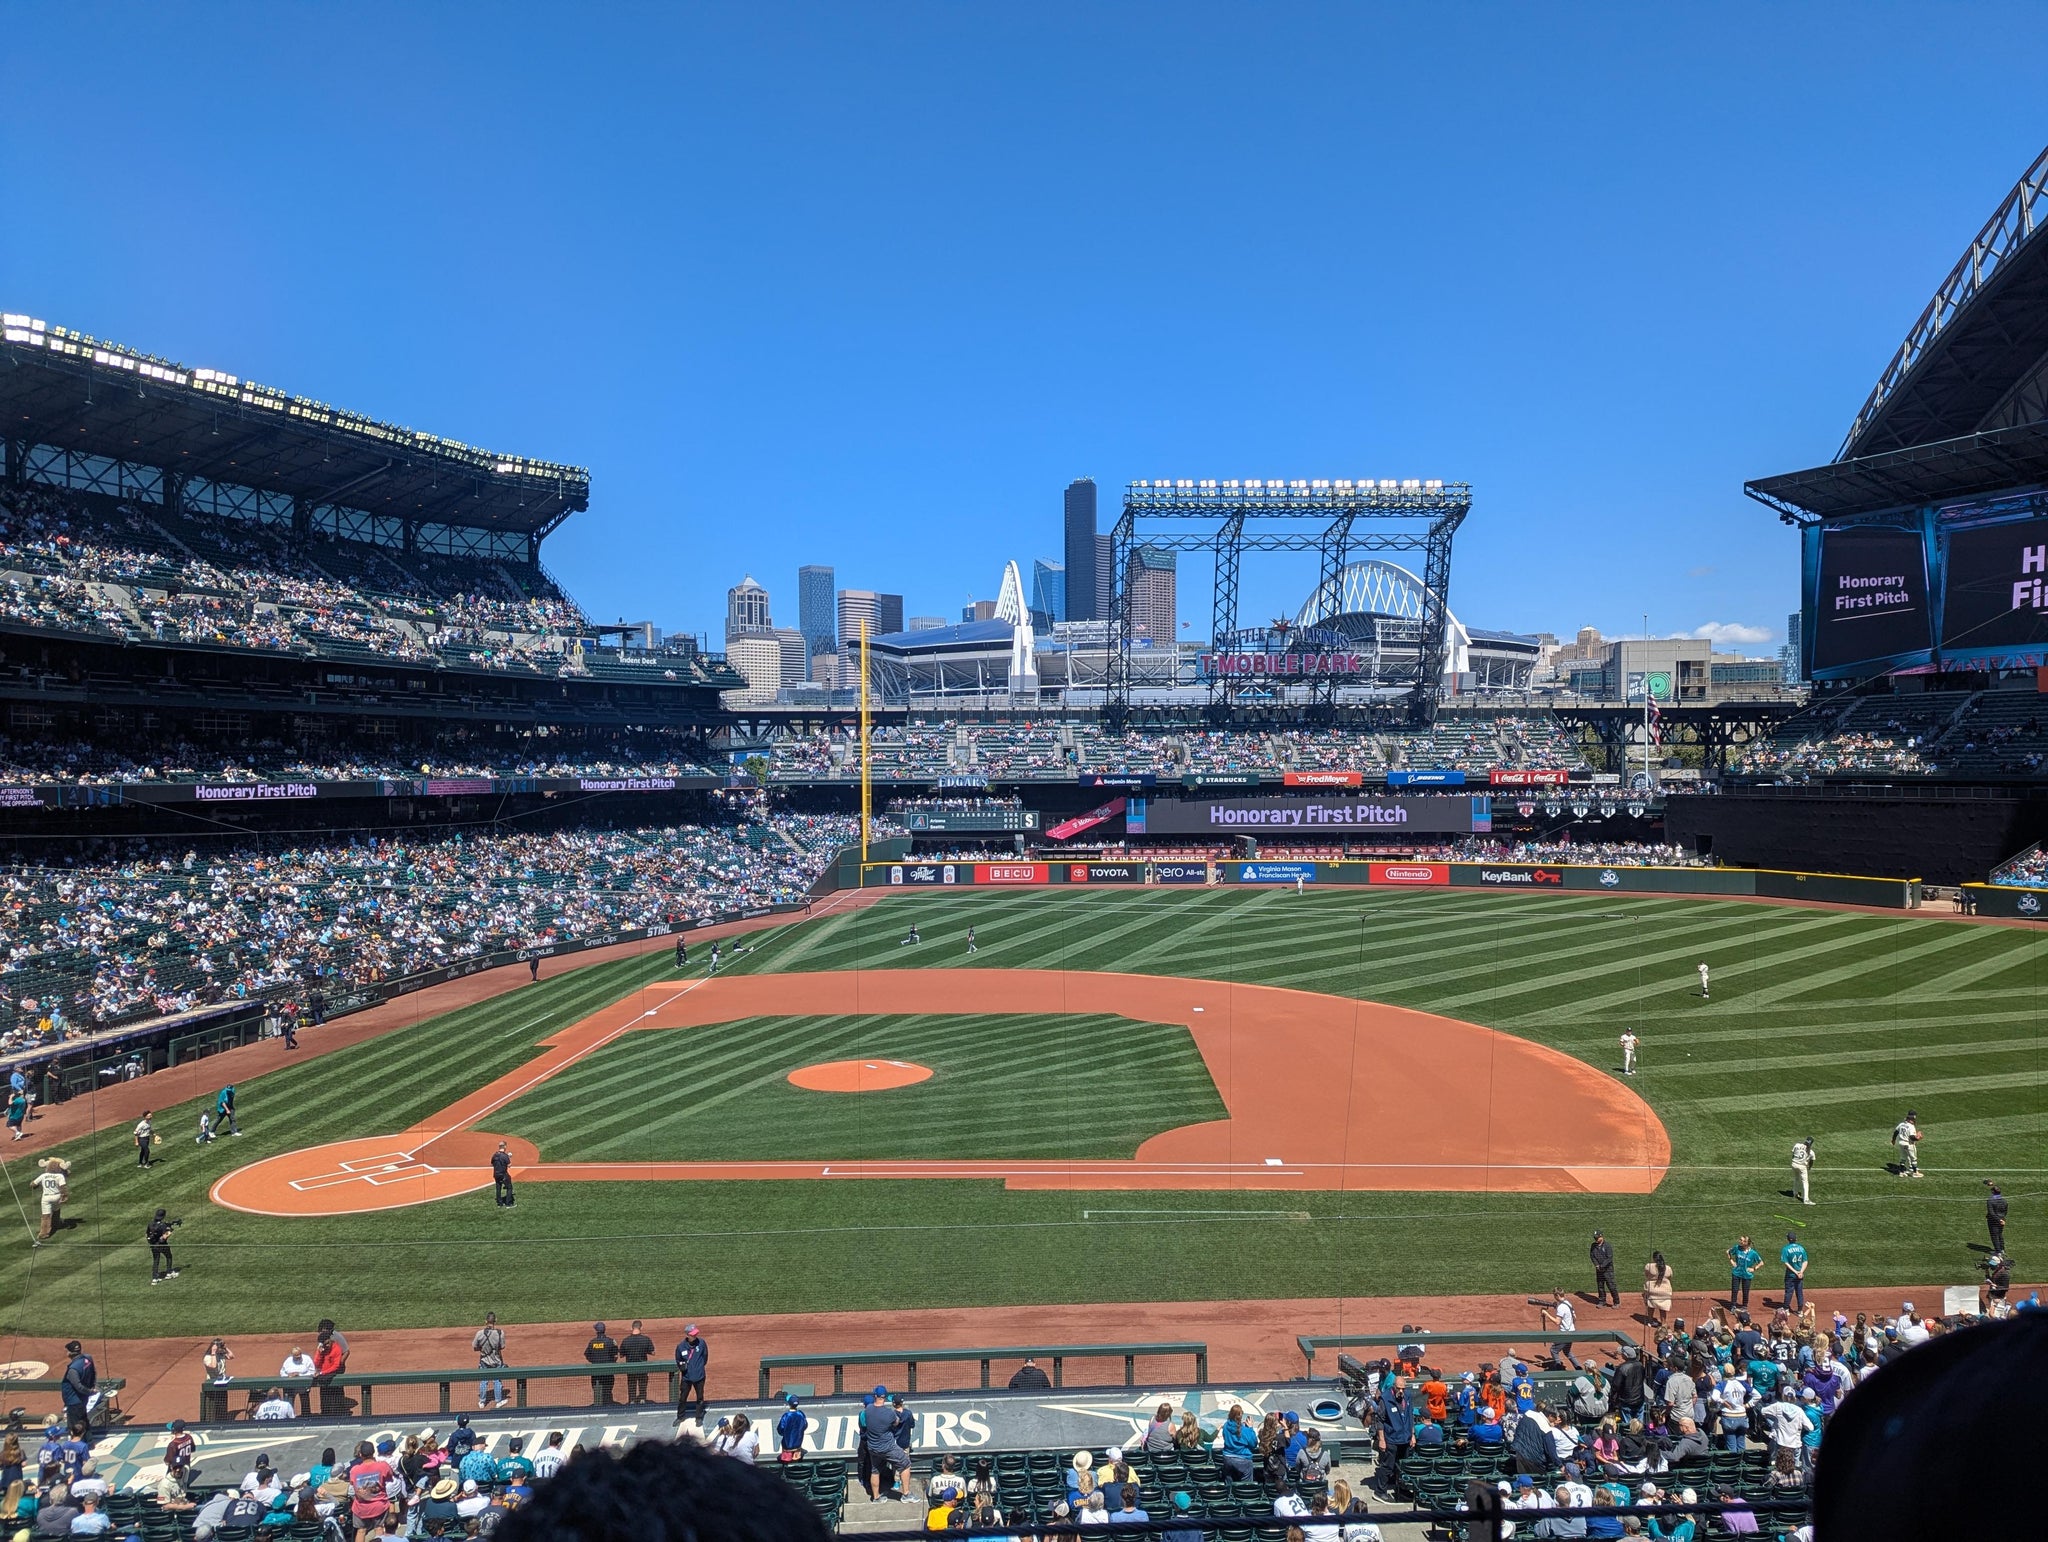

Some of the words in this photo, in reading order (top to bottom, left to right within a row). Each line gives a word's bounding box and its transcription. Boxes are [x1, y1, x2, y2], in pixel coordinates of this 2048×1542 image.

[2021, 545, 2048, 573] H
[1839, 575, 1905, 589] Honorary
[1835, 594, 1872, 610] First
[1875, 590, 1909, 606] Pitch
[1215, 627, 1266, 649] SEATTLE
[1292, 626, 1350, 649] MARINERS
[619, 656, 641, 665] Trident
[642, 656, 657, 665] Deck
[1200, 653, 1300, 674] T-MOBILE
[1303, 653, 1361, 674] PARK
[195, 785, 255, 799] Honorary
[257, 784, 286, 797] First
[287, 783, 317, 796] Pitch
[580, 778, 627, 790] Honorary
[627, 778, 650, 789] First
[651, 778, 676, 789] Pitch
[1025, 813, 1033, 828] S
[1210, 805, 1303, 825] Honorary
[1306, 805, 1353, 823] First
[1356, 805, 1407, 823] Pitch
[992, 869, 1031, 878] BECU
[1090, 867, 1129, 877] TOYOTA
[1258, 865, 1281, 873] Virginia
[1389, 869, 1427, 878] Nintendo
[1482, 871, 1532, 883] KeyBank
[2022, 897, 2037, 907] 50
[646, 924, 672, 937] STIHL
[584, 938, 602, 948] Great
[602, 934, 618, 945] Clips
[1576, 1493, 1584, 1507] 3
